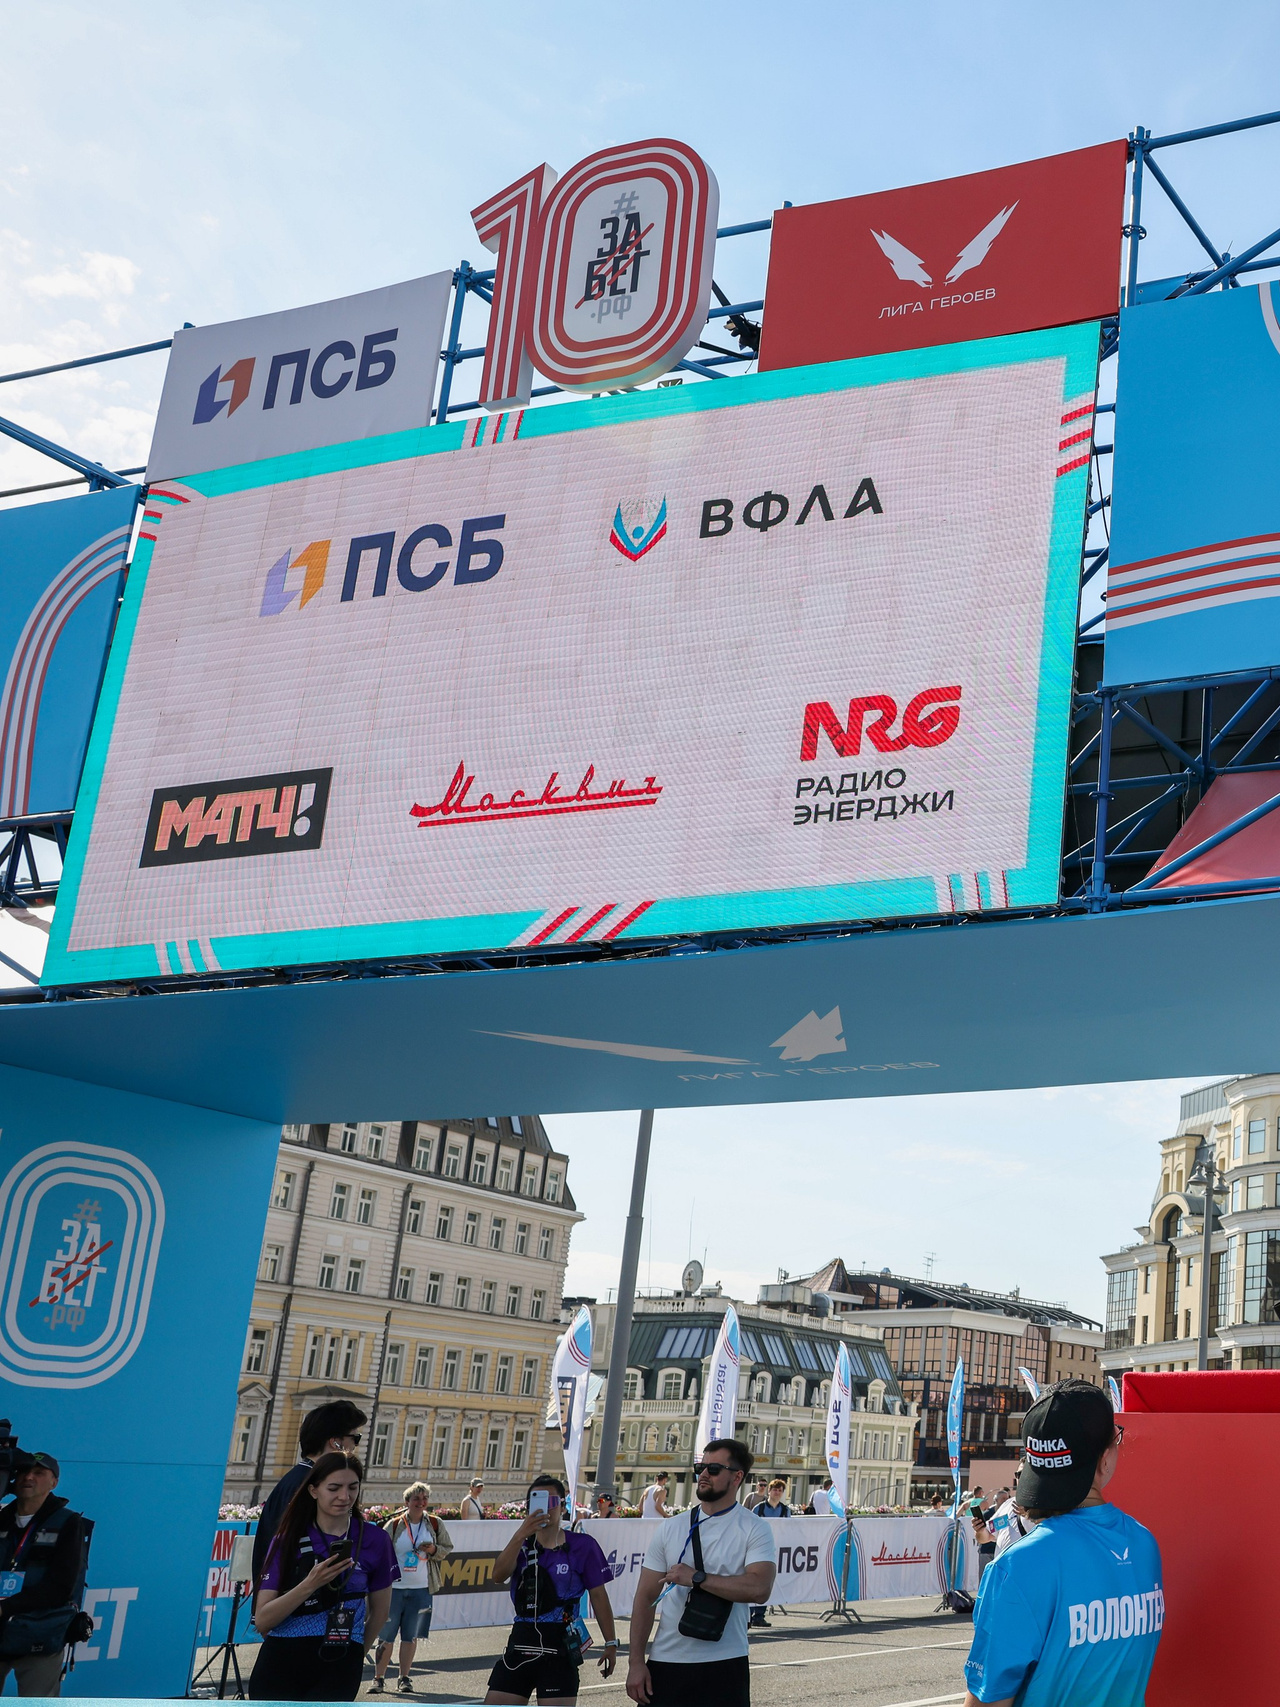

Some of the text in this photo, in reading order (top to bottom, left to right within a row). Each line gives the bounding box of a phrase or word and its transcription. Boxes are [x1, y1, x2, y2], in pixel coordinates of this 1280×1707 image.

[878, 287, 996, 319] ЛИГА ГЕРОЕВ
[262, 328, 399, 410] ПСБ
[698, 477, 884, 539] ВФЛА
[340, 513, 506, 602] ПСБ
[800, 685, 962, 762] NRG
[796, 768, 907, 798] РАДИО
[154, 783, 317, 852] МАТЧ!
[793, 790, 954, 825] ЭНЕРДЖИ
[677, 1061, 941, 1082] ЛИГА ГЕРОЕВ
[1026, 1452, 1072, 1468] ГЕРОЕВ
[1027, 1436, 1067, 1452] ГОНКА
[777, 1546, 818, 1573] ПСБ
